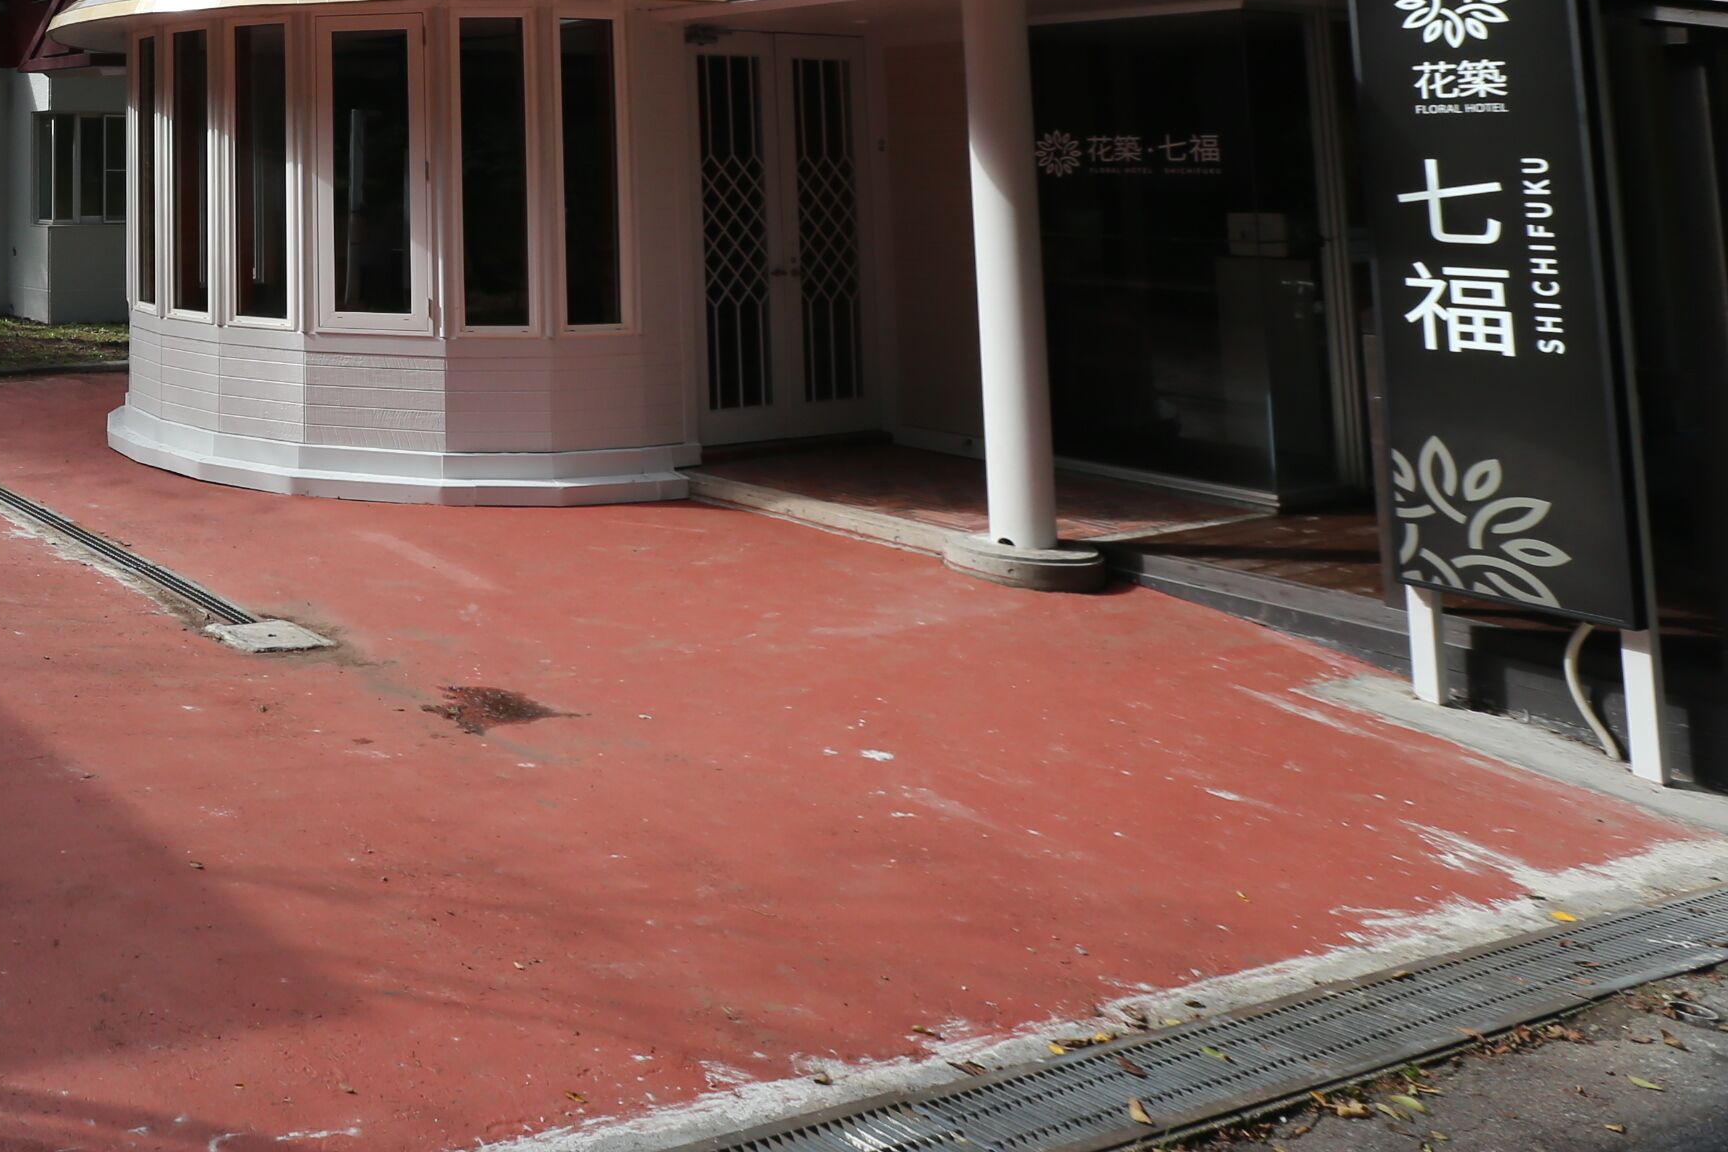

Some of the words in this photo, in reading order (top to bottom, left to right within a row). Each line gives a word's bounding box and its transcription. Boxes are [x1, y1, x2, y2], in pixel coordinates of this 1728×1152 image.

[1411, 58, 1509, 100] 花築
[1414, 103, 1463, 116] FLORAL
[1464, 101, 1510, 115] HOTEL
[1087, 133, 1222, 163] 花築・七福
[1396, 158, 1516, 358] 七福
[1519, 156, 1566, 356] SHICHIFUKU
